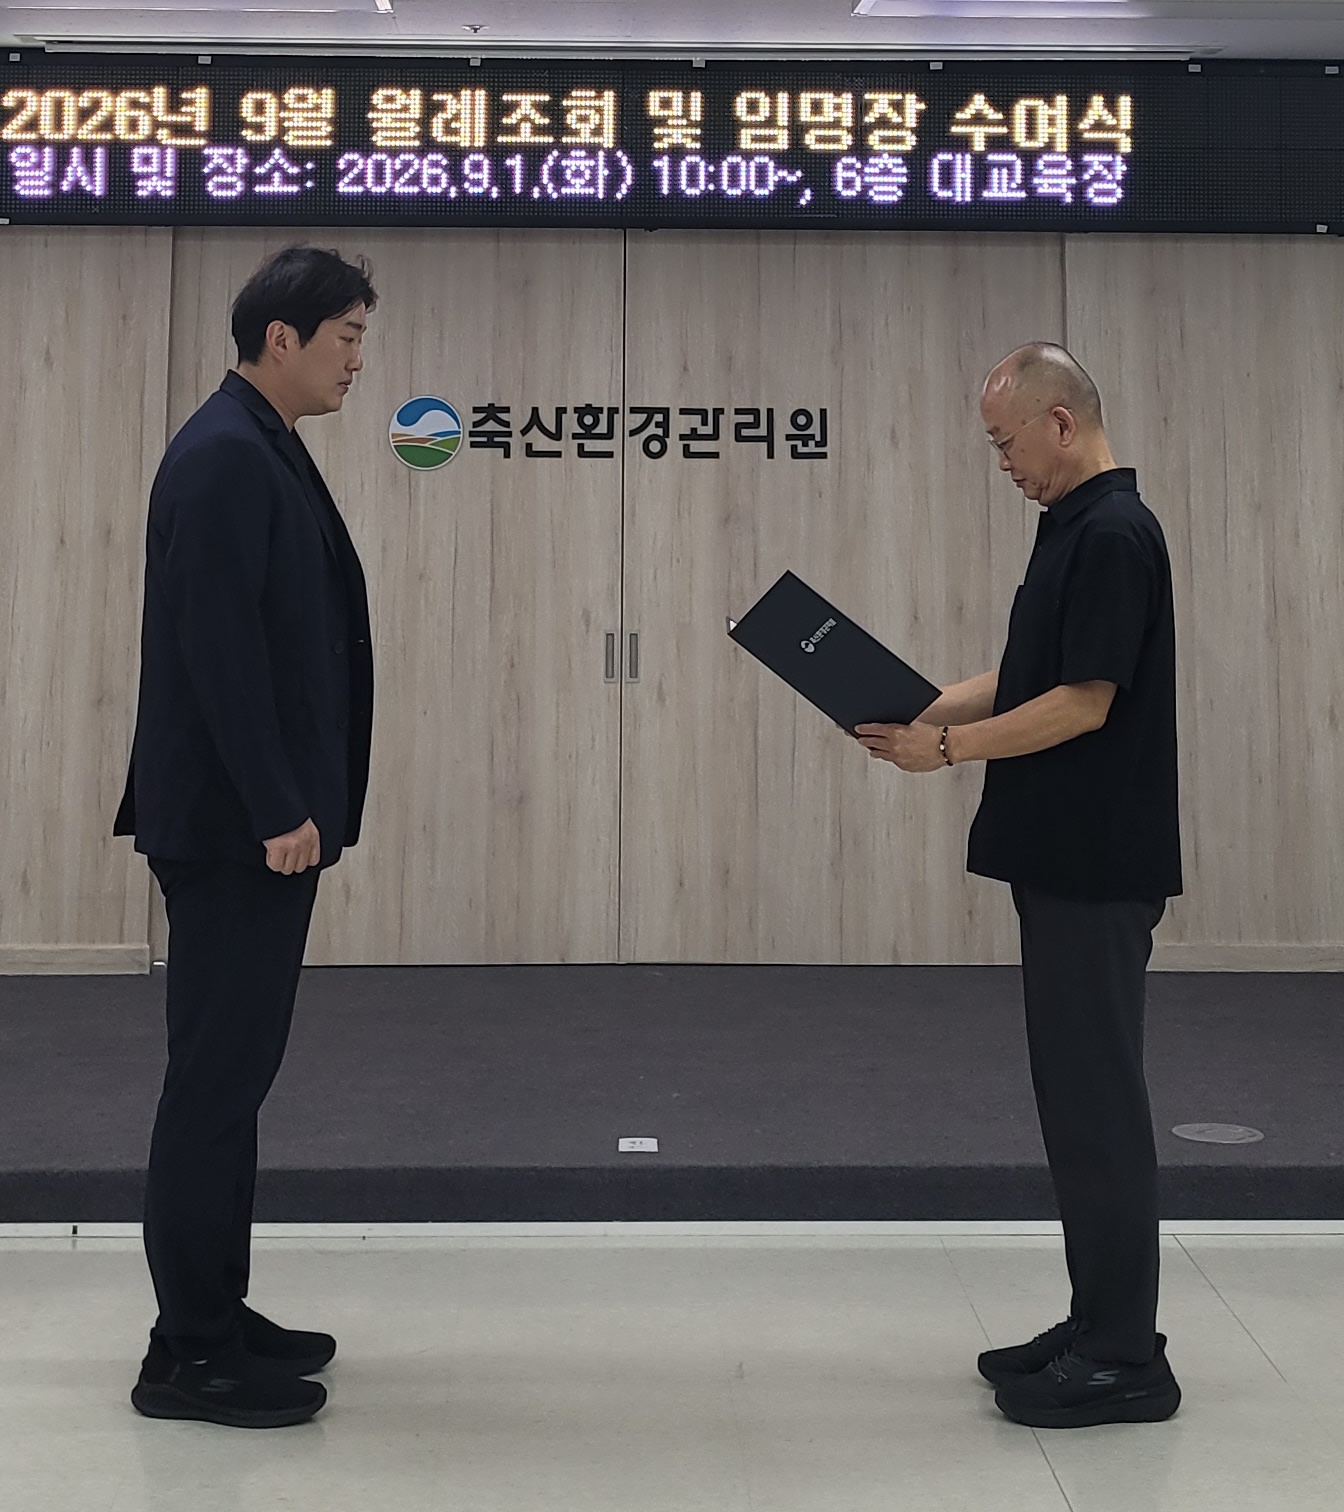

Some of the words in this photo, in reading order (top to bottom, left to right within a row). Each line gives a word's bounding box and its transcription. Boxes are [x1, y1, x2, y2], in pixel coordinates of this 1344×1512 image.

[0, 85, 211, 147] 2026년
[239, 86, 337, 148] 9월
[367, 87, 616, 150] 월례조회
[647, 90, 702, 150] 및
[735, 90, 926, 153] 임명장
[950, 93, 1133, 154] 수여식
[8, 144, 109, 199] 일시
[130, 144, 178, 199] 및
[202, 145, 316, 199] 장소:
[834, 152, 908, 204] 6층
[930, 152, 1128, 207] 대교육장
[469, 402, 828, 459] 축산환경관리원
